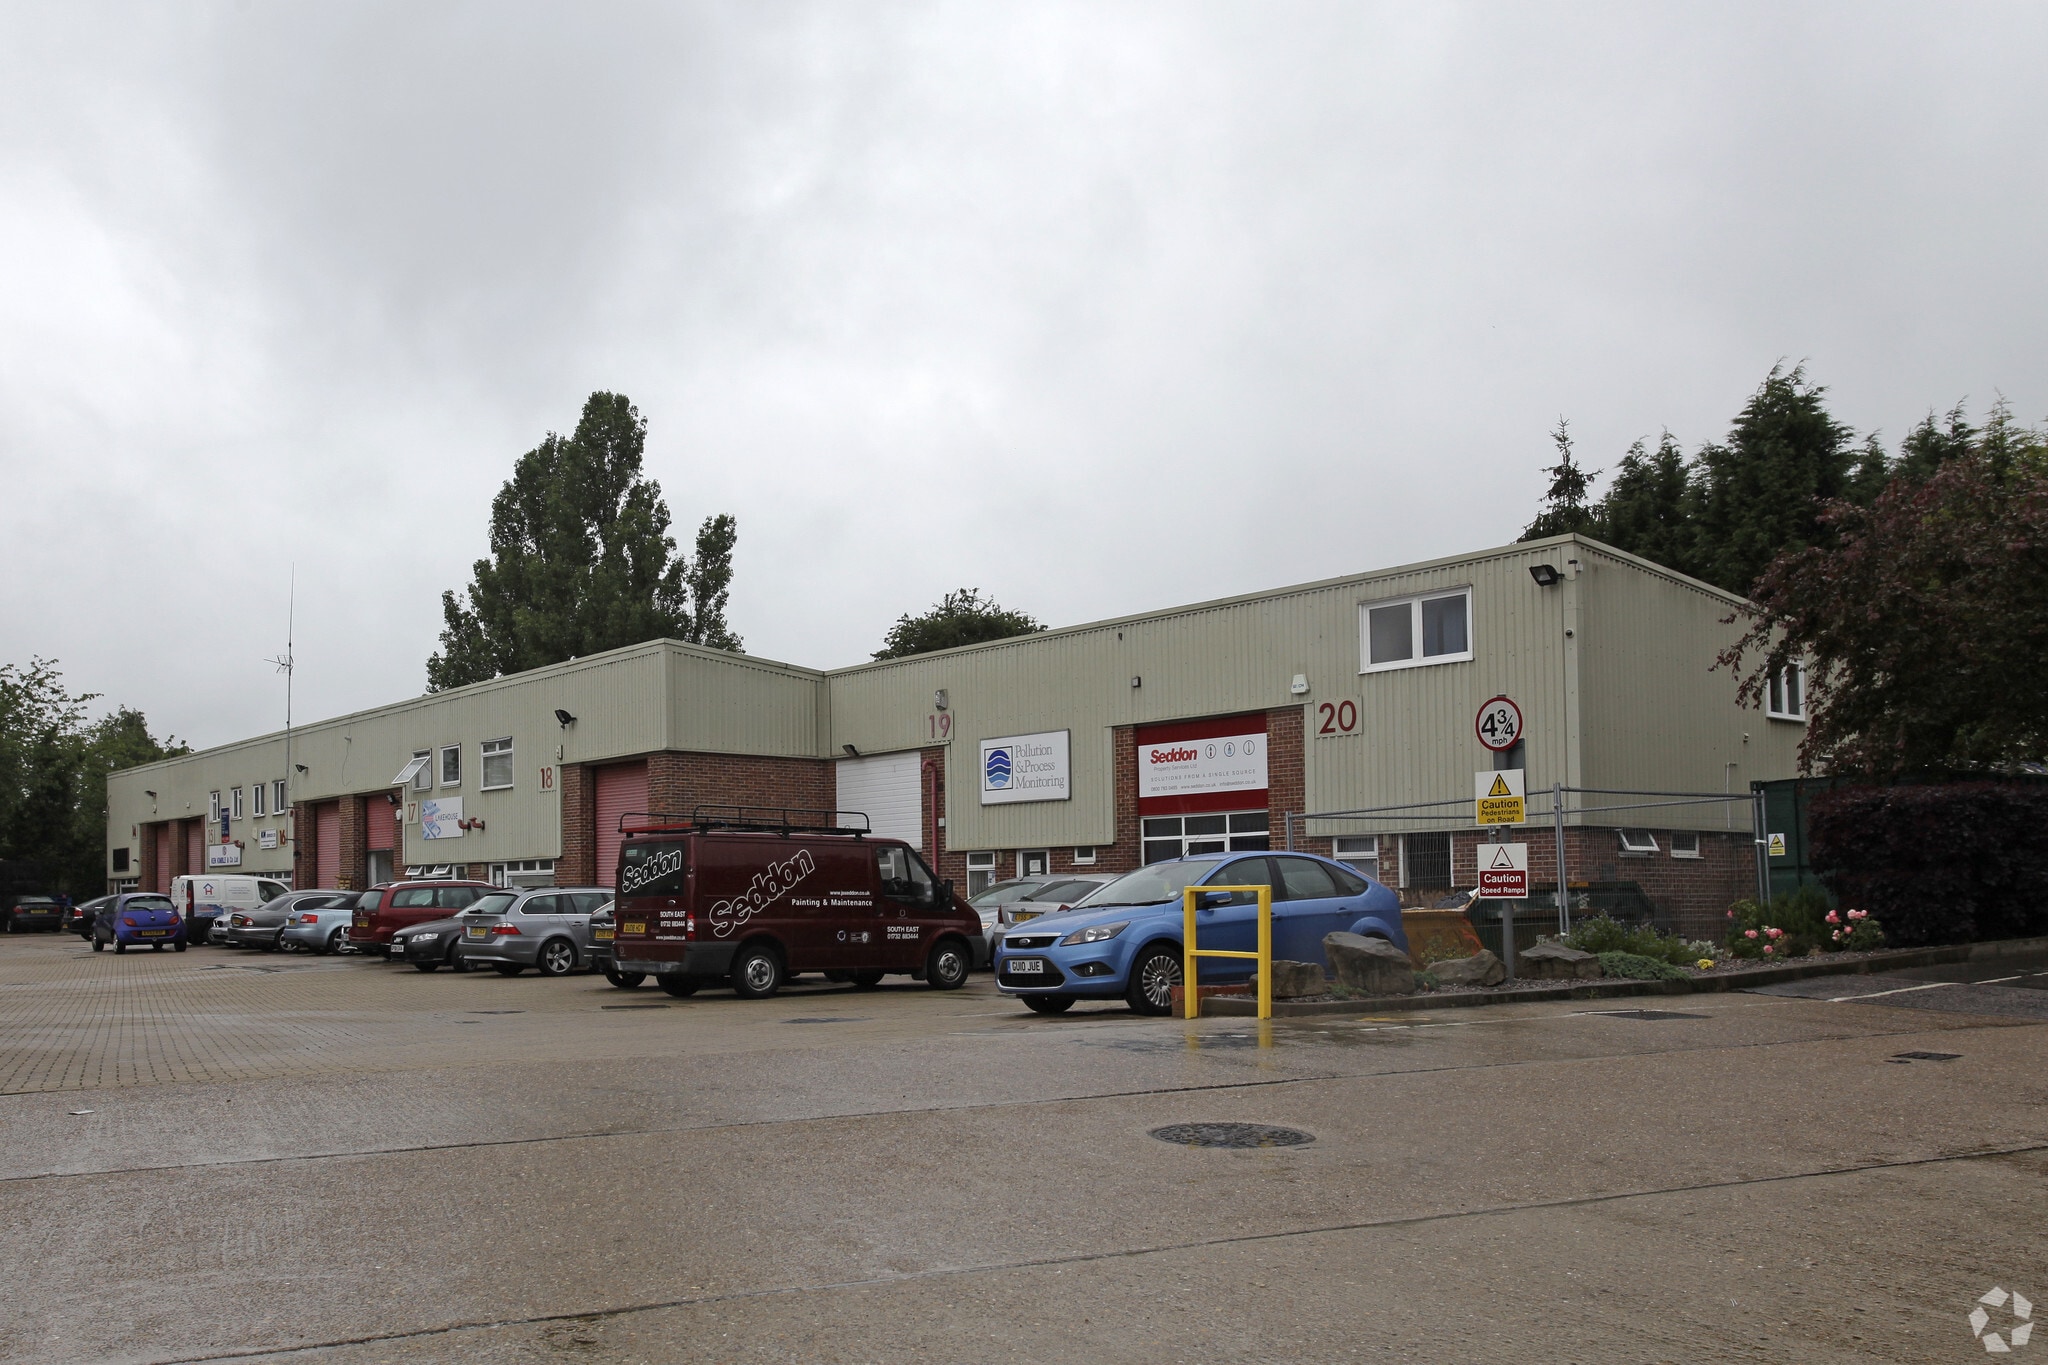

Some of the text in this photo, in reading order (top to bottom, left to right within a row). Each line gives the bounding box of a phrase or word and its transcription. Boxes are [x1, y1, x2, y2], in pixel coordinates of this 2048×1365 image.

[1319, 700, 1357, 734] 20
[929, 713, 951, 738] 19
[1492, 737, 1508, 745] mph
[1015, 744, 1053, 758] Pollution
[1150, 747, 1198, 764] Seddon
[541, 767, 553, 789] 18
[1015, 775, 1064, 789] Monitoring
[1151, 774, 1182, 782] SOLUTIONS
[1232, 768, 1256, 776] SOURCE
[1481, 800, 1519, 809] Caution
[408, 803, 416, 821] 17
[1481, 809, 1520, 817] Pedestrians
[279, 829, 286, 845] 16
[622, 849, 682, 893] Seddon
[1484, 873, 1522, 883] Caution
[709, 849, 815, 938] Seddon
[1481, 886, 1525, 894] Speed Ramps
[791, 898, 820, 907] Painting
[830, 898, 873, 906] Maintenance
[1012, 961, 1041, 972] GU10 JUE
